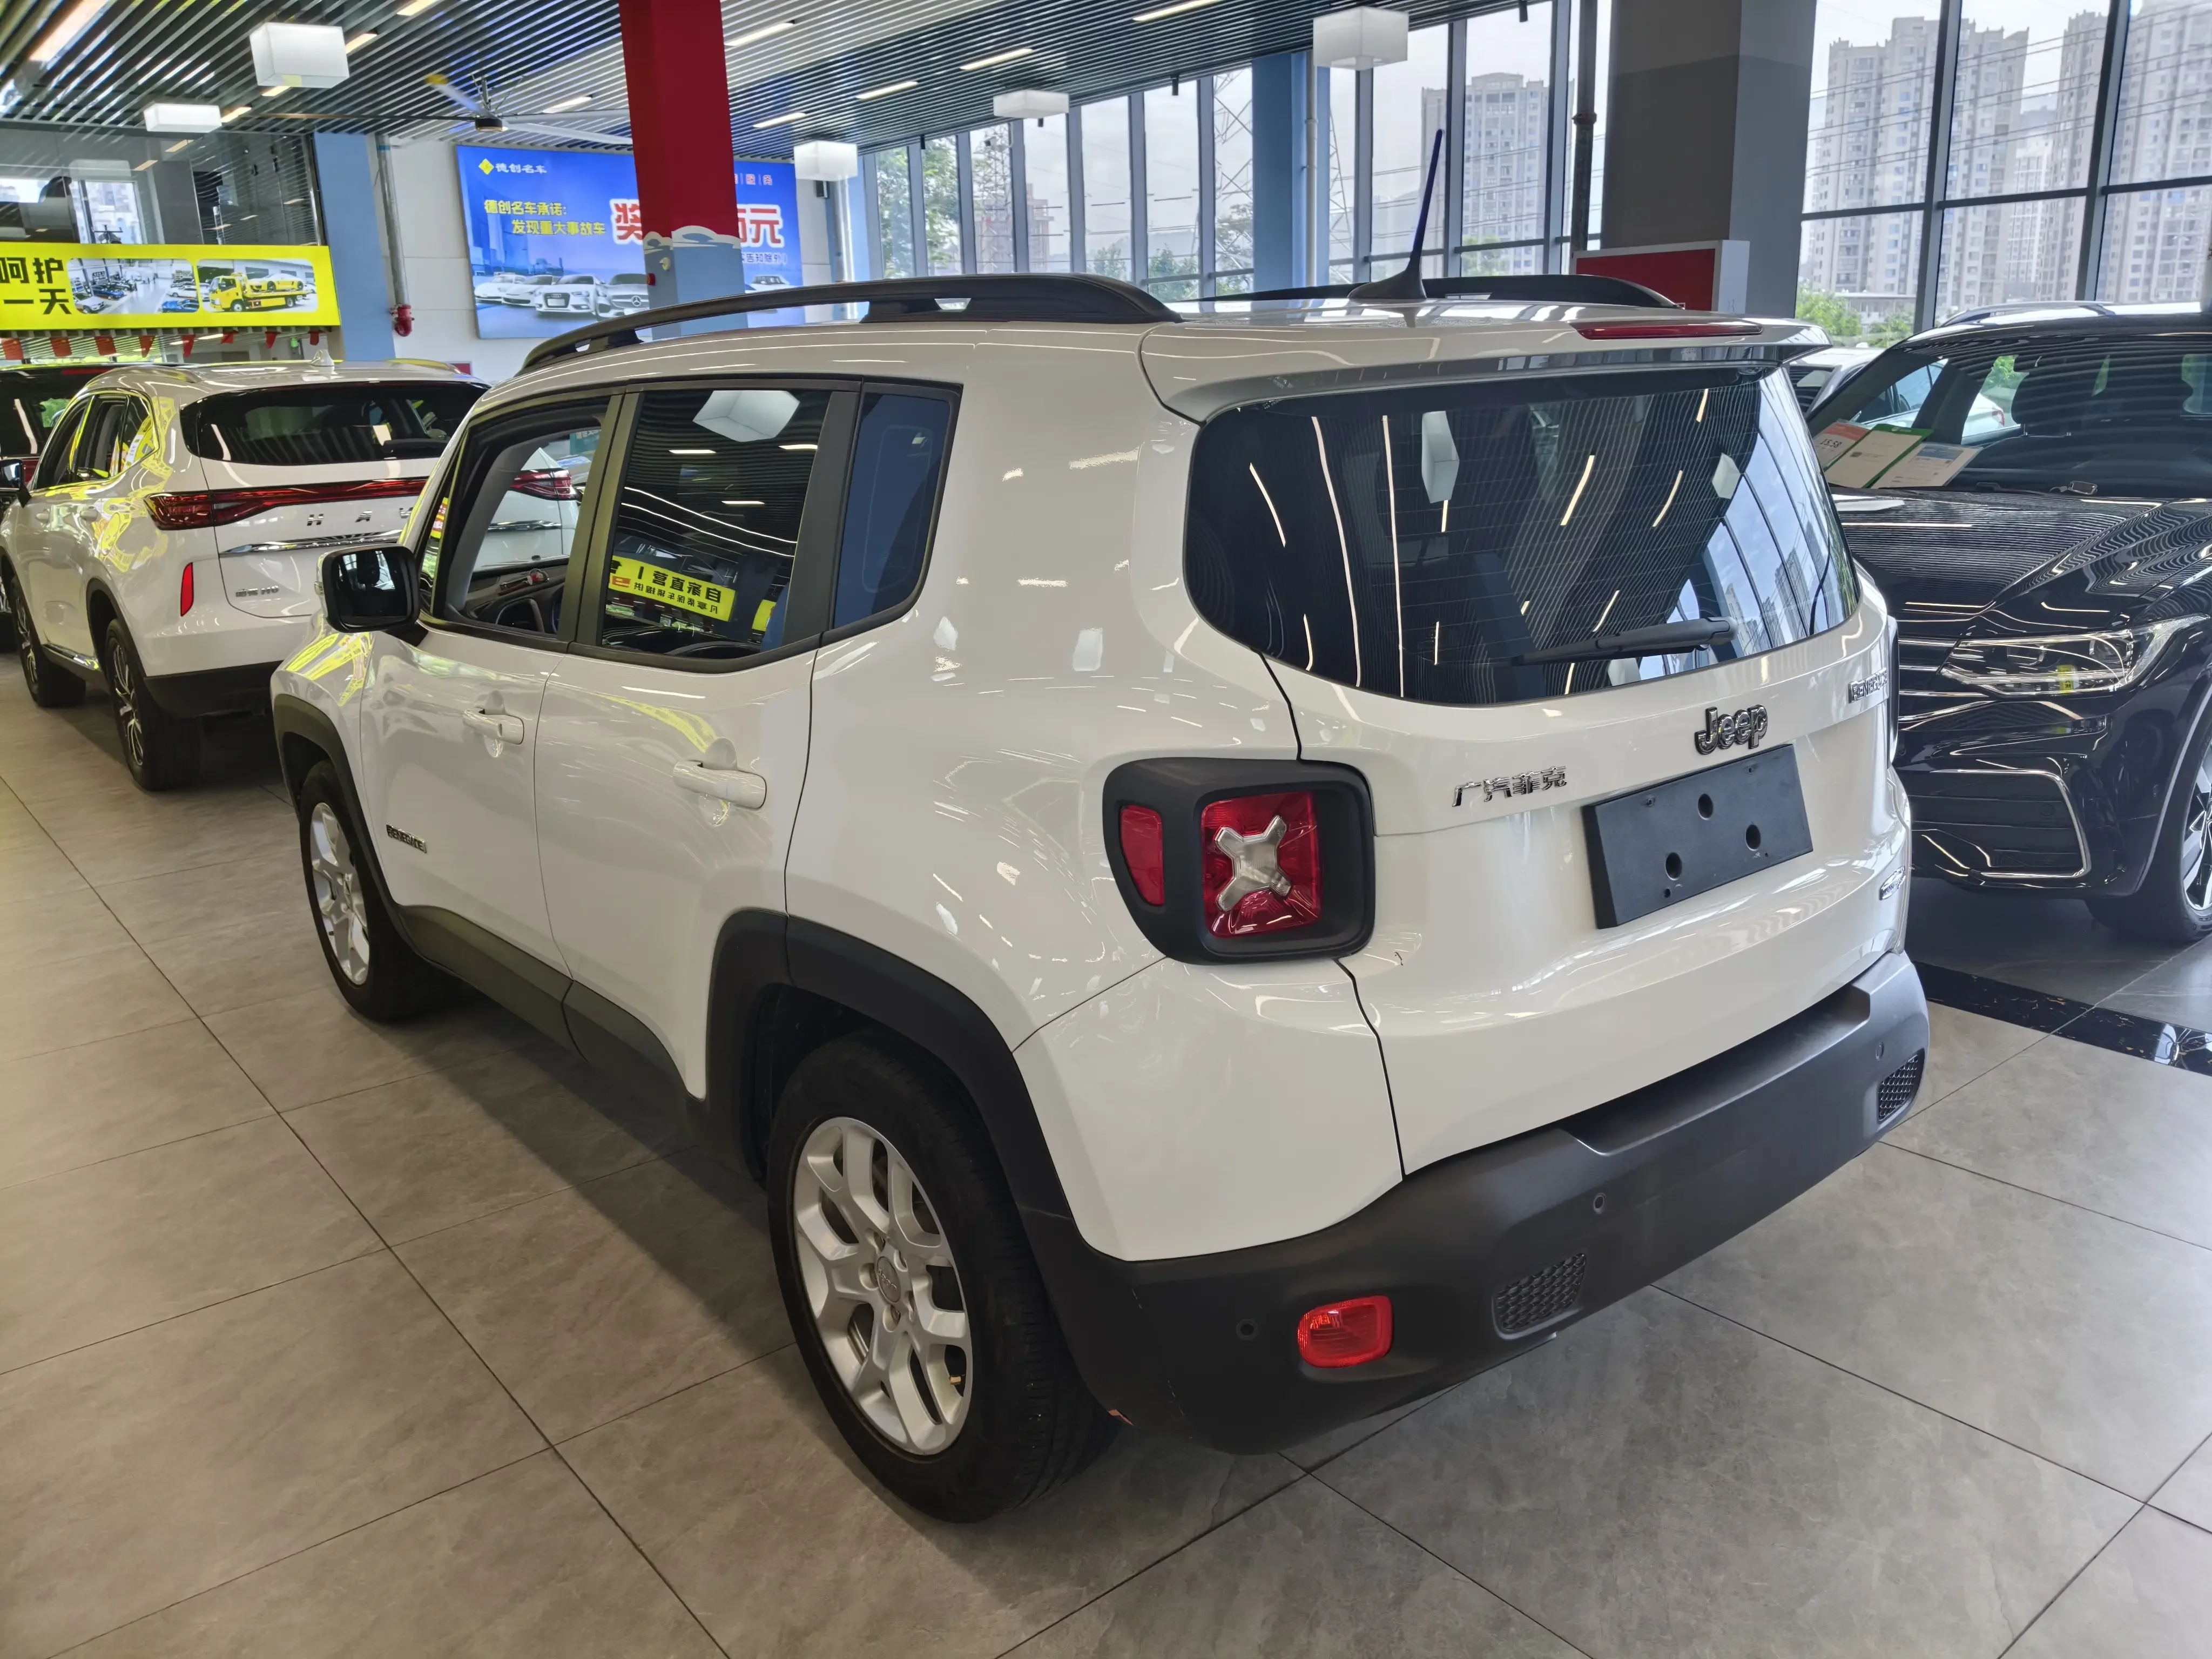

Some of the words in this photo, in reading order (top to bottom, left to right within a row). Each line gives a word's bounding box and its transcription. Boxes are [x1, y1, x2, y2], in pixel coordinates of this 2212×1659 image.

[512, 219, 606, 236] 发现重大事故车
[3, 288, 72, 315] 一天
[1694, 704, 1768, 755] Jeep
[1452, 766, 1568, 807] 广汽菲克
